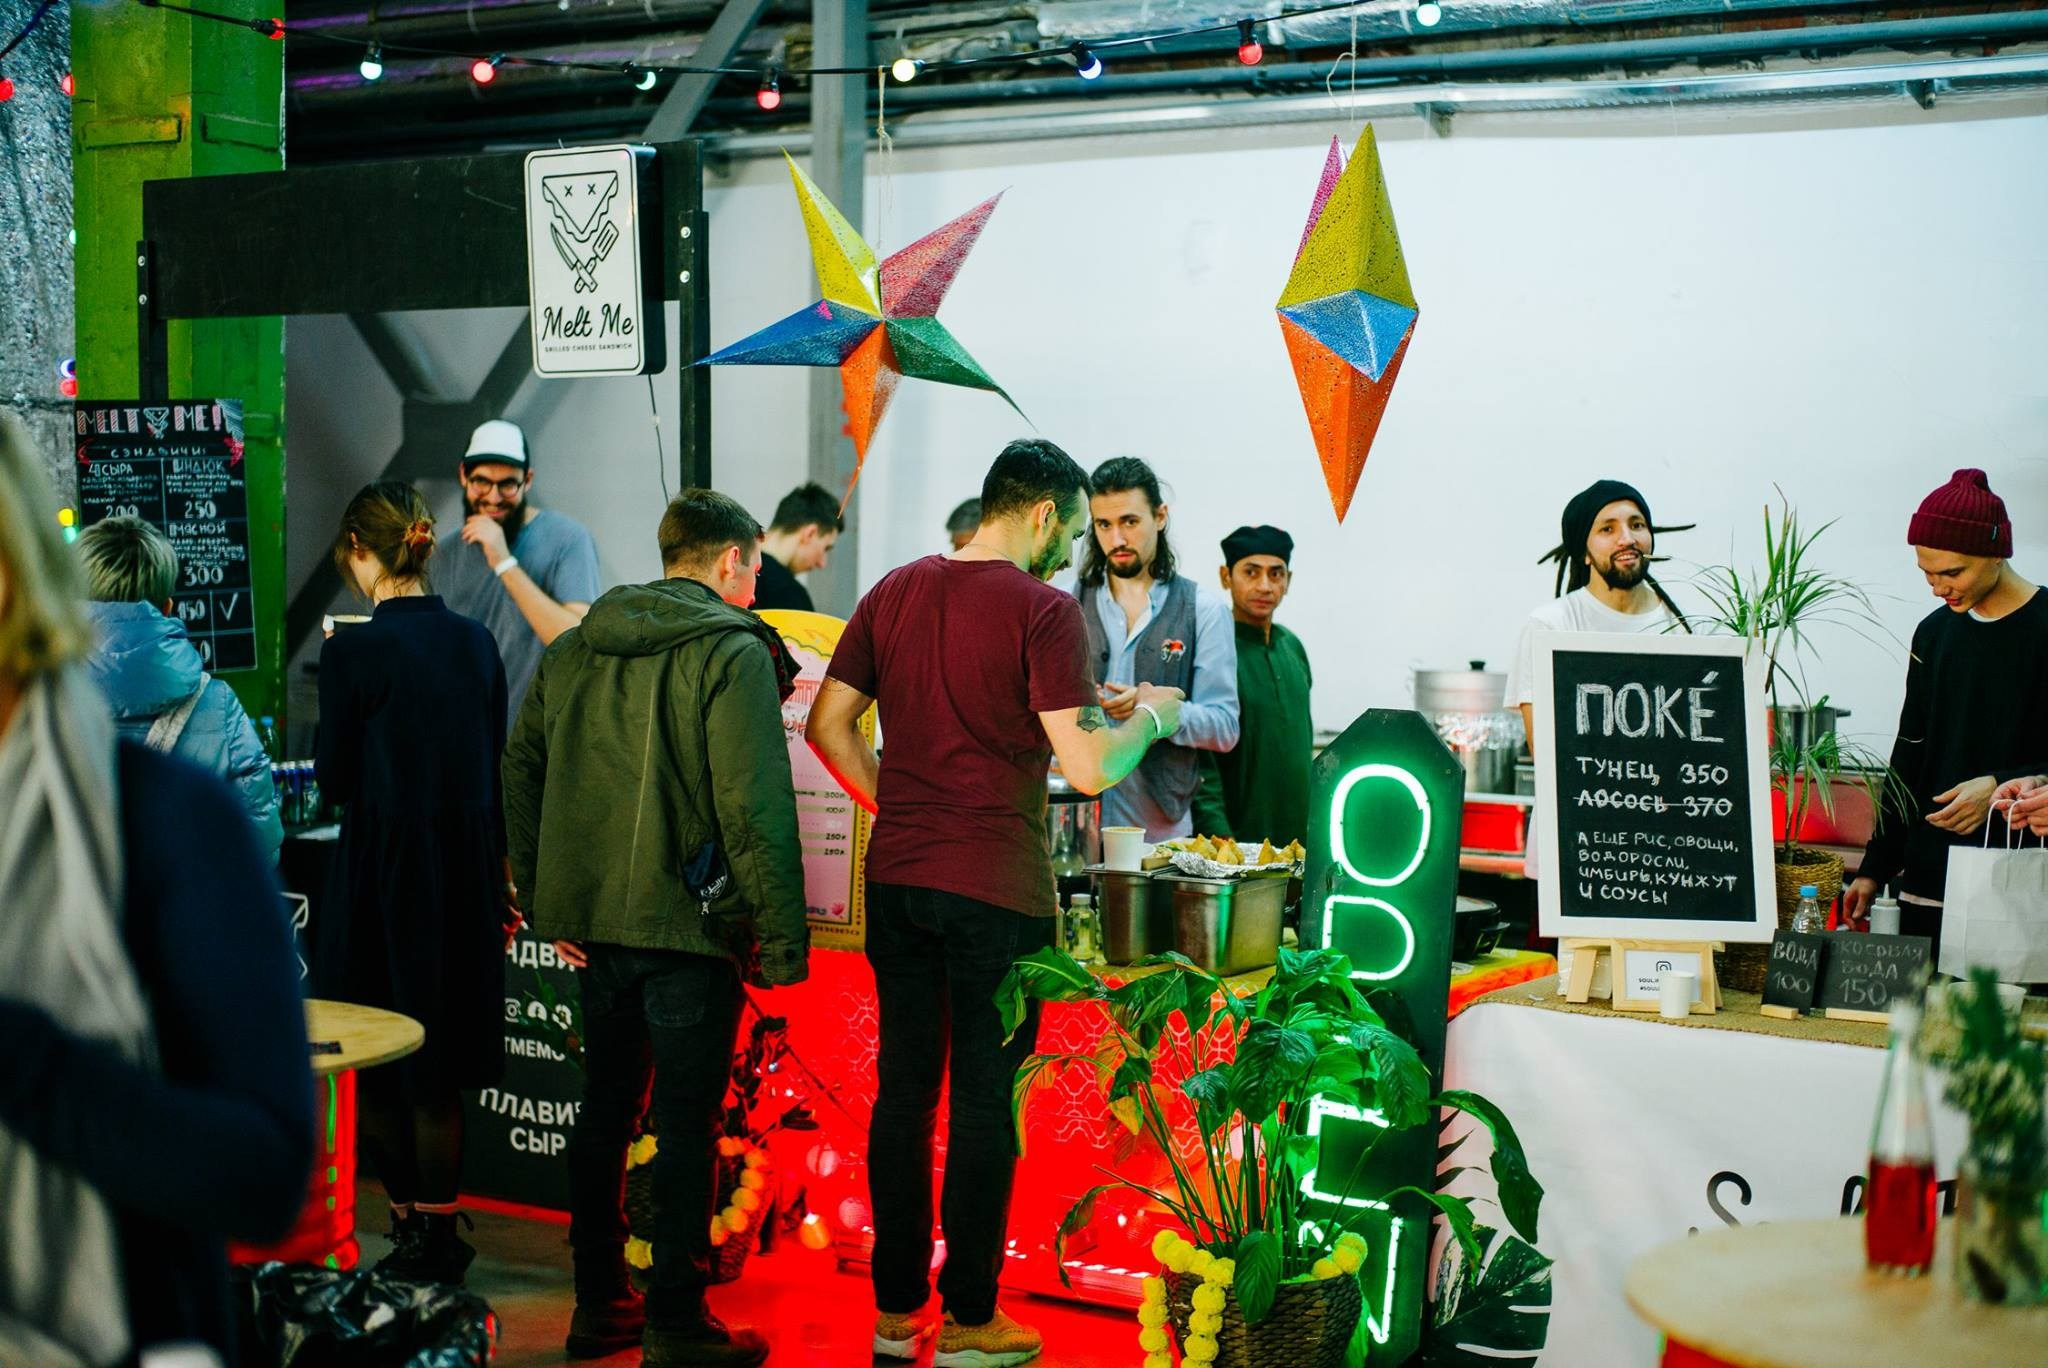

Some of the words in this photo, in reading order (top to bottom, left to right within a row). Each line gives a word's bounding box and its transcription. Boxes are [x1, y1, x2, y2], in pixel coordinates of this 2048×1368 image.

[542, 306, 592, 341] Melt
[599, 303, 634, 338] Me
[76, 408, 140, 435] MELT
[174, 405, 221, 431] ME!
[102, 462, 133, 476] СЫРА
[184, 500, 217, 519] 250
[169, 520, 226, 537] МЯСНОЙ
[184, 565, 224, 587] 300
[1575, 756, 1660, 786] ТУНЕЦ
[1680, 763, 1729, 785] 350
[1683, 796, 1733, 817] 370
[1578, 832, 1589, 846] А
[1579, 882, 1592, 899] И
[1600, 885, 1668, 905] СОУСЫ
[1773, 941, 1817, 970] ВОДА
[1841, 960, 1898, 980] ВОДА
[1774, 971, 1811, 994] 100
[1839, 978, 1888, 1006] 150
[480, 1088, 582, 1126] ПЛАВИ
[510, 1127, 566, 1156] СЫР
